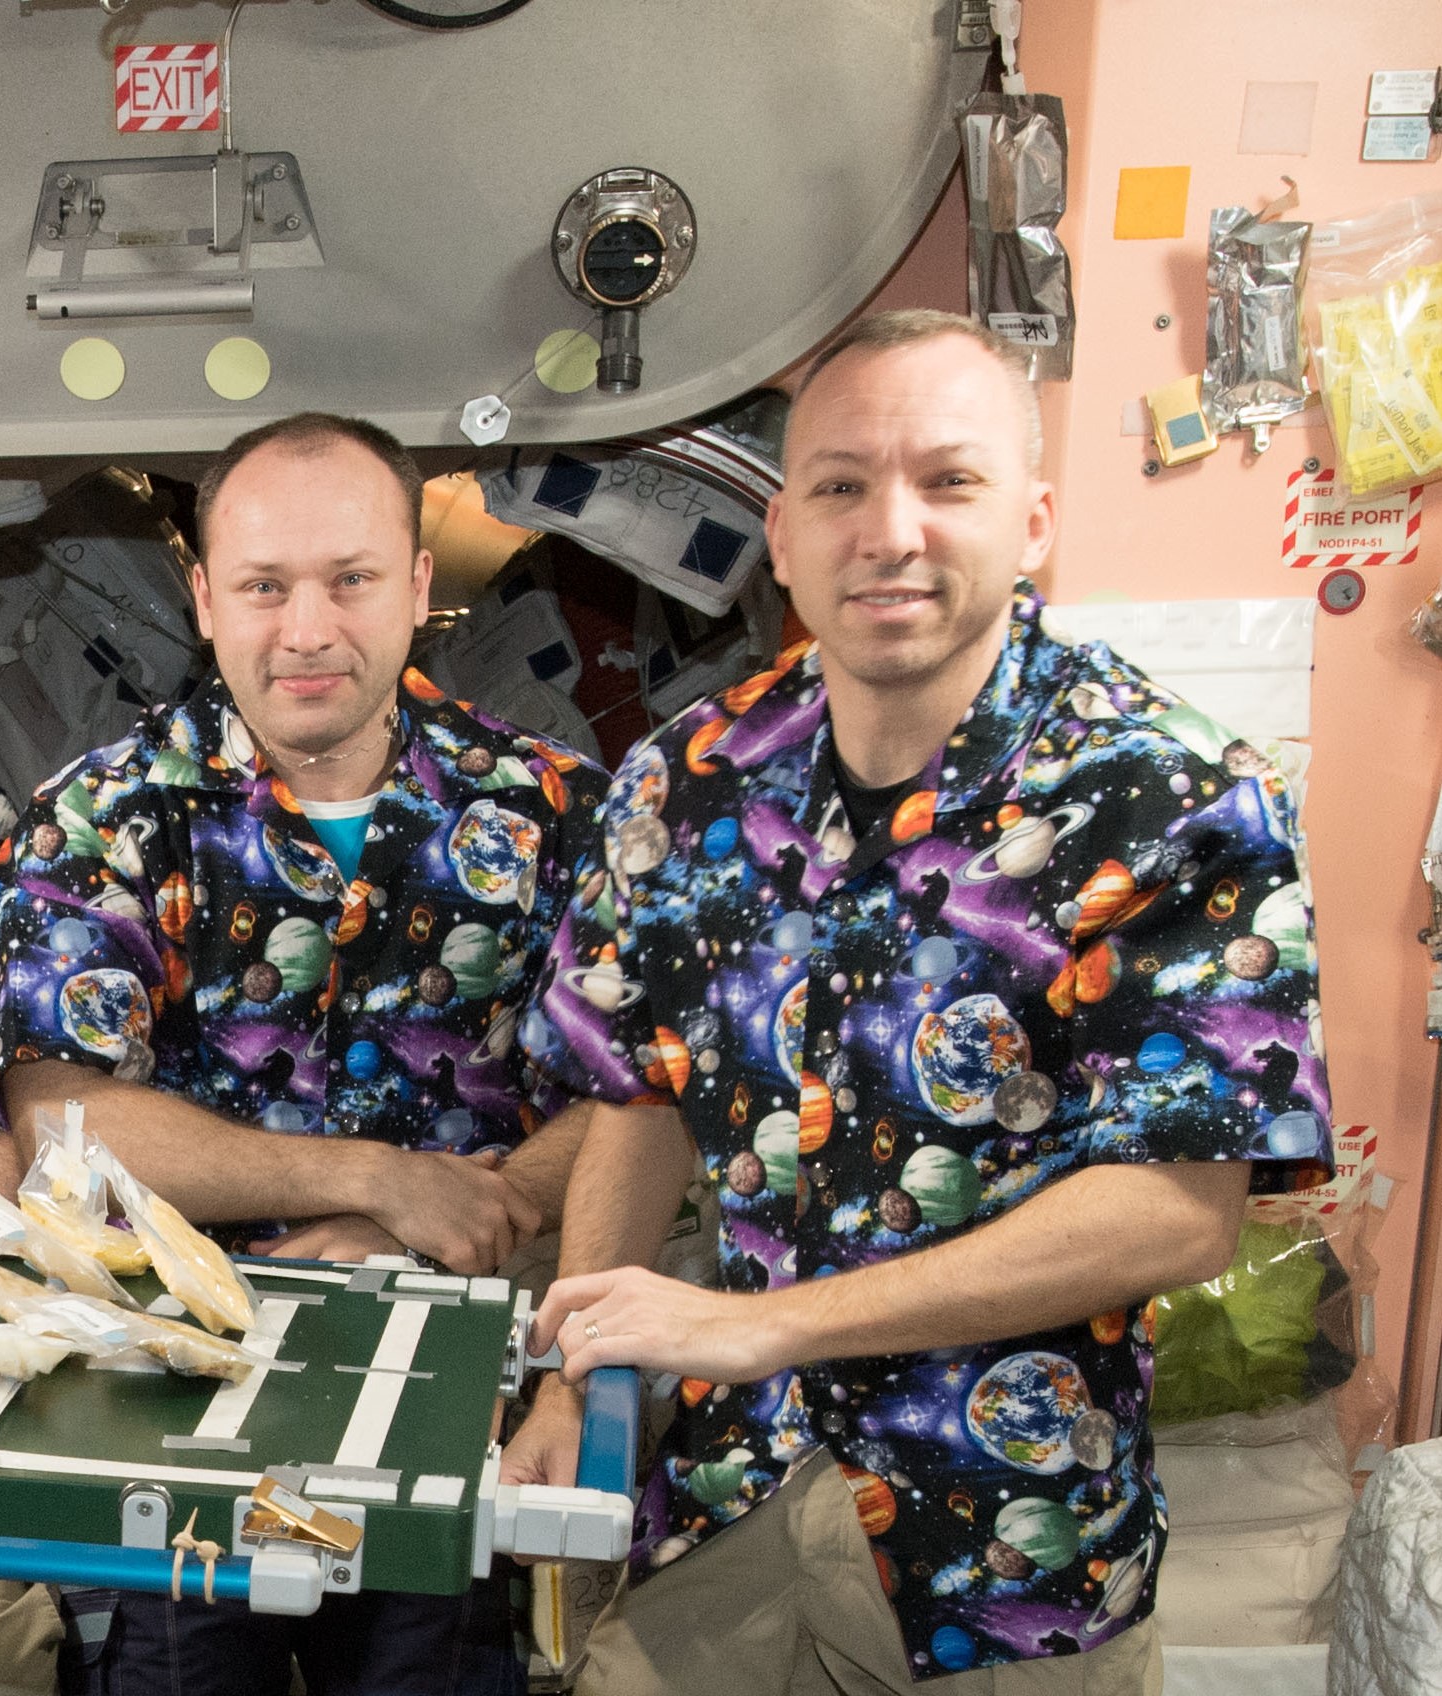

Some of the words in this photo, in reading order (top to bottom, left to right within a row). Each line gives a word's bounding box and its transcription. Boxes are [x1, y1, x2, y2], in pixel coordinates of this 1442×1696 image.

[131, 66, 204, 112] EXIT
[1303, 511, 1345, 527] FIRE
[1351, 509, 1405, 525] PORT
[1318, 537, 1383, 549] NOD1P4-51
[1338, 1142, 1362, 1152] USE
[1335, 1164, 1358, 1177] RT
